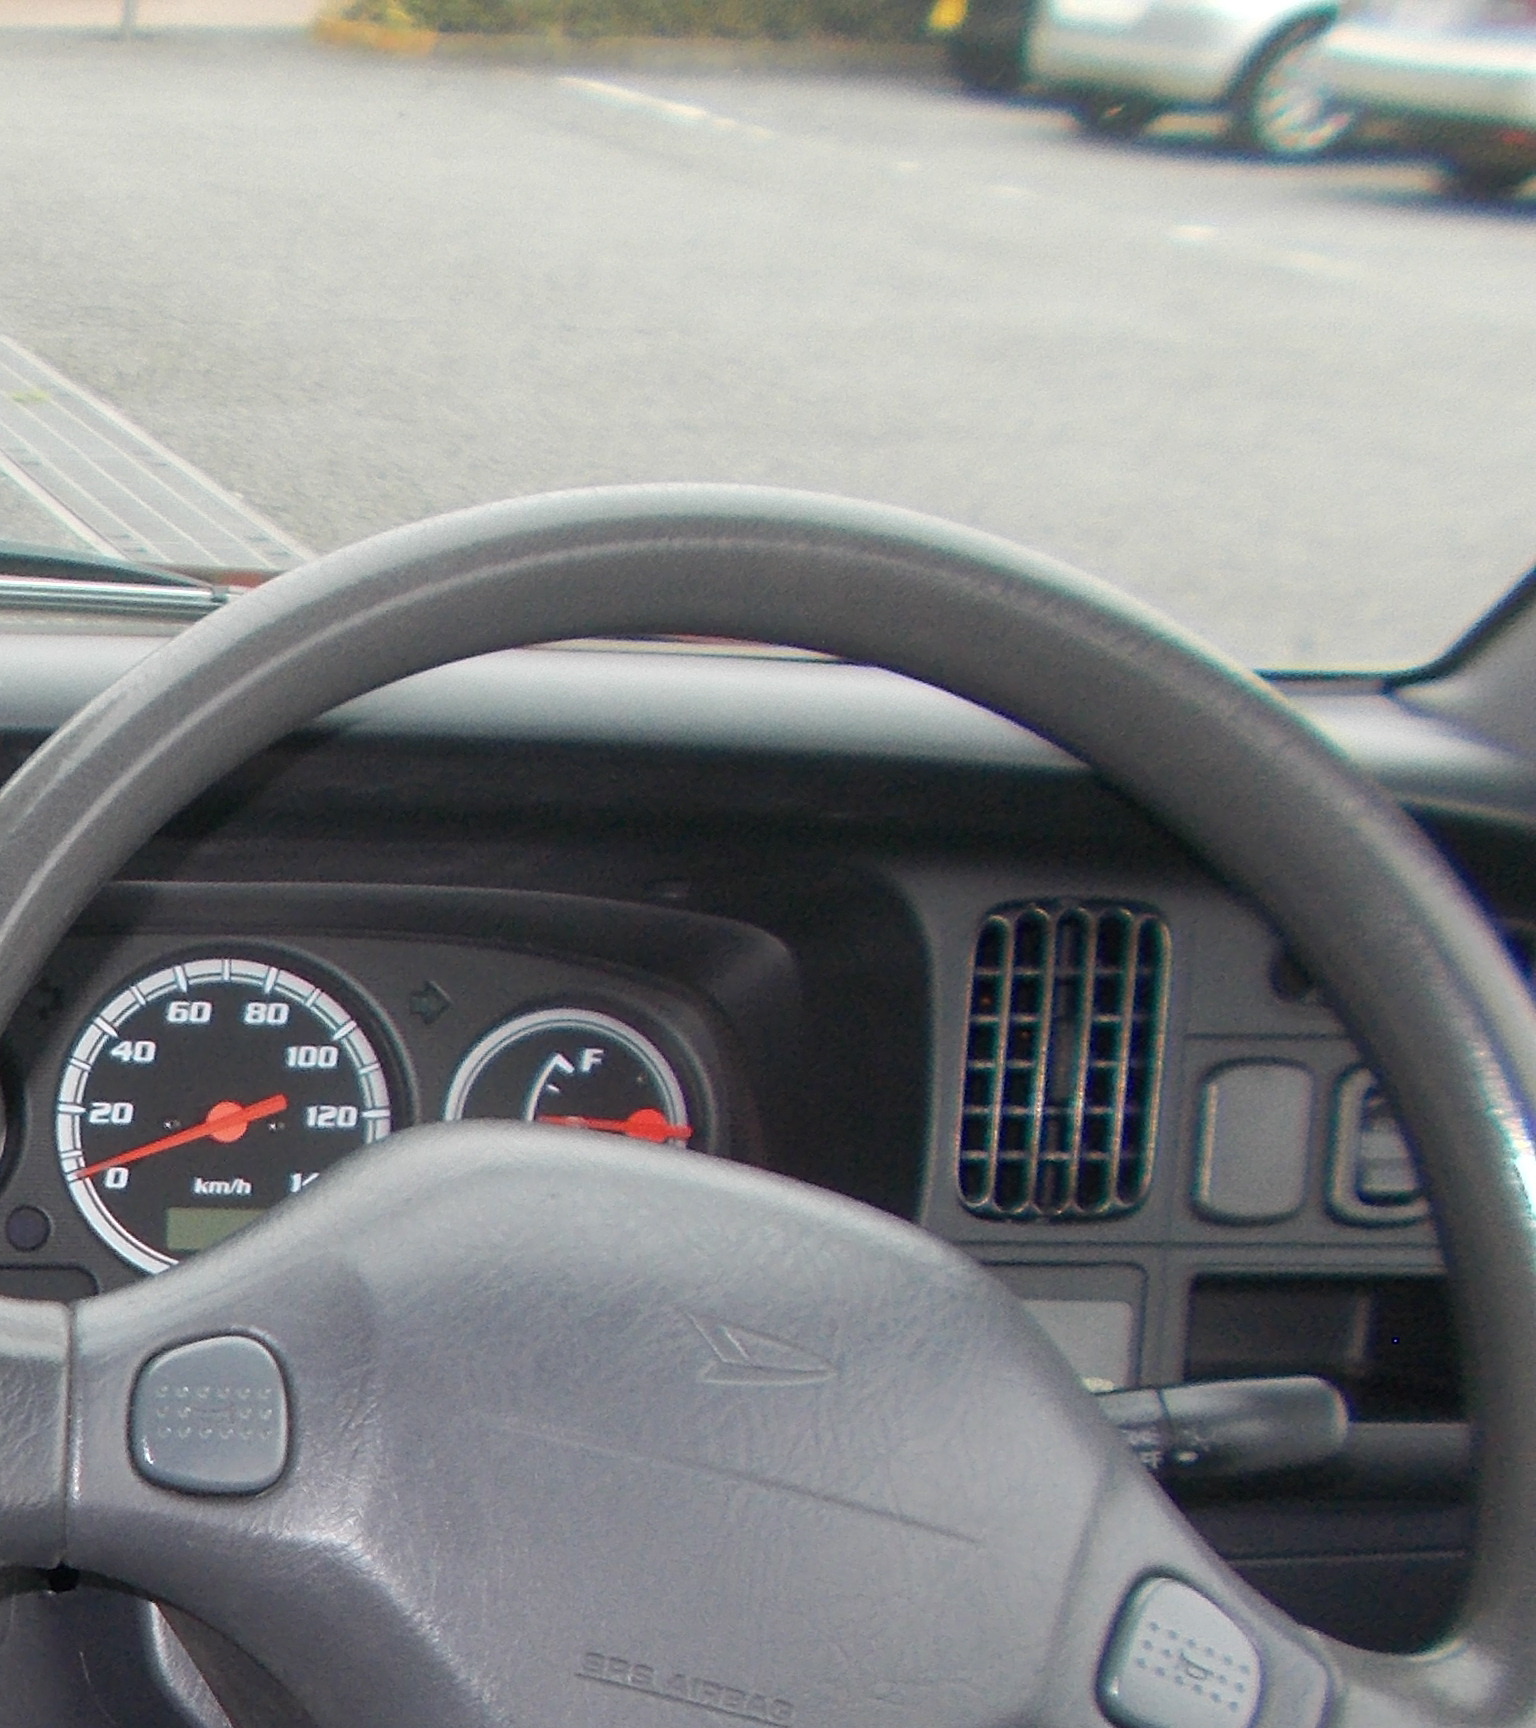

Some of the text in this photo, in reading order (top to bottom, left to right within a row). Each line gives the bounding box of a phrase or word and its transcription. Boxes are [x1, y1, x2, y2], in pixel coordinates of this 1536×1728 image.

[166, 1000, 212, 1024] 60
[243, 1001, 290, 1025] 80
[110, 1039, 157, 1063] 40
[286, 1045, 339, 1068] 100
[580, 1048, 605, 1072] F
[88, 1101, 134, 1125] 20
[306, 1105, 359, 1128] 120
[103, 1166, 129, 1190] 0
[193, 1176, 253, 1195] km/h
